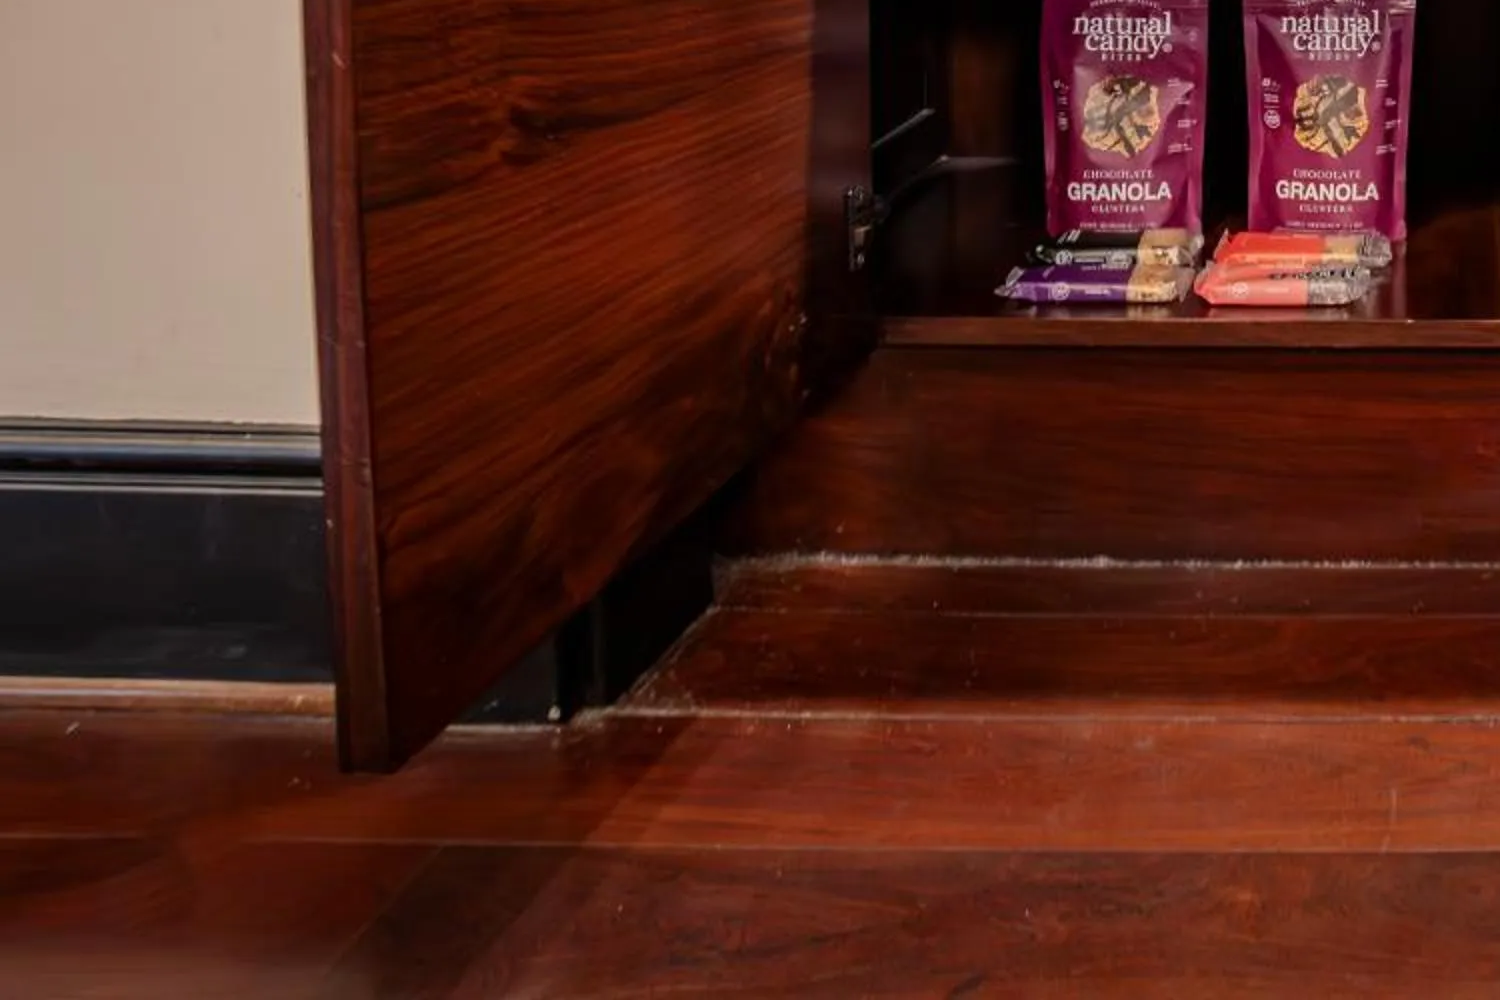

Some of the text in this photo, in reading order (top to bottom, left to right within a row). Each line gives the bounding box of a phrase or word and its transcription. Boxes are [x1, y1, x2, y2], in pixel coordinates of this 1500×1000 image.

[1072, 10, 1172, 35] natural
[1280, 9, 1381, 34] natural
[1084, 31, 1165, 60] candy
[1293, 30, 1375, 57] candy
[1067, 181, 1172, 201] GRANOLA
[1275, 179, 1379, 201] GRANOLA
